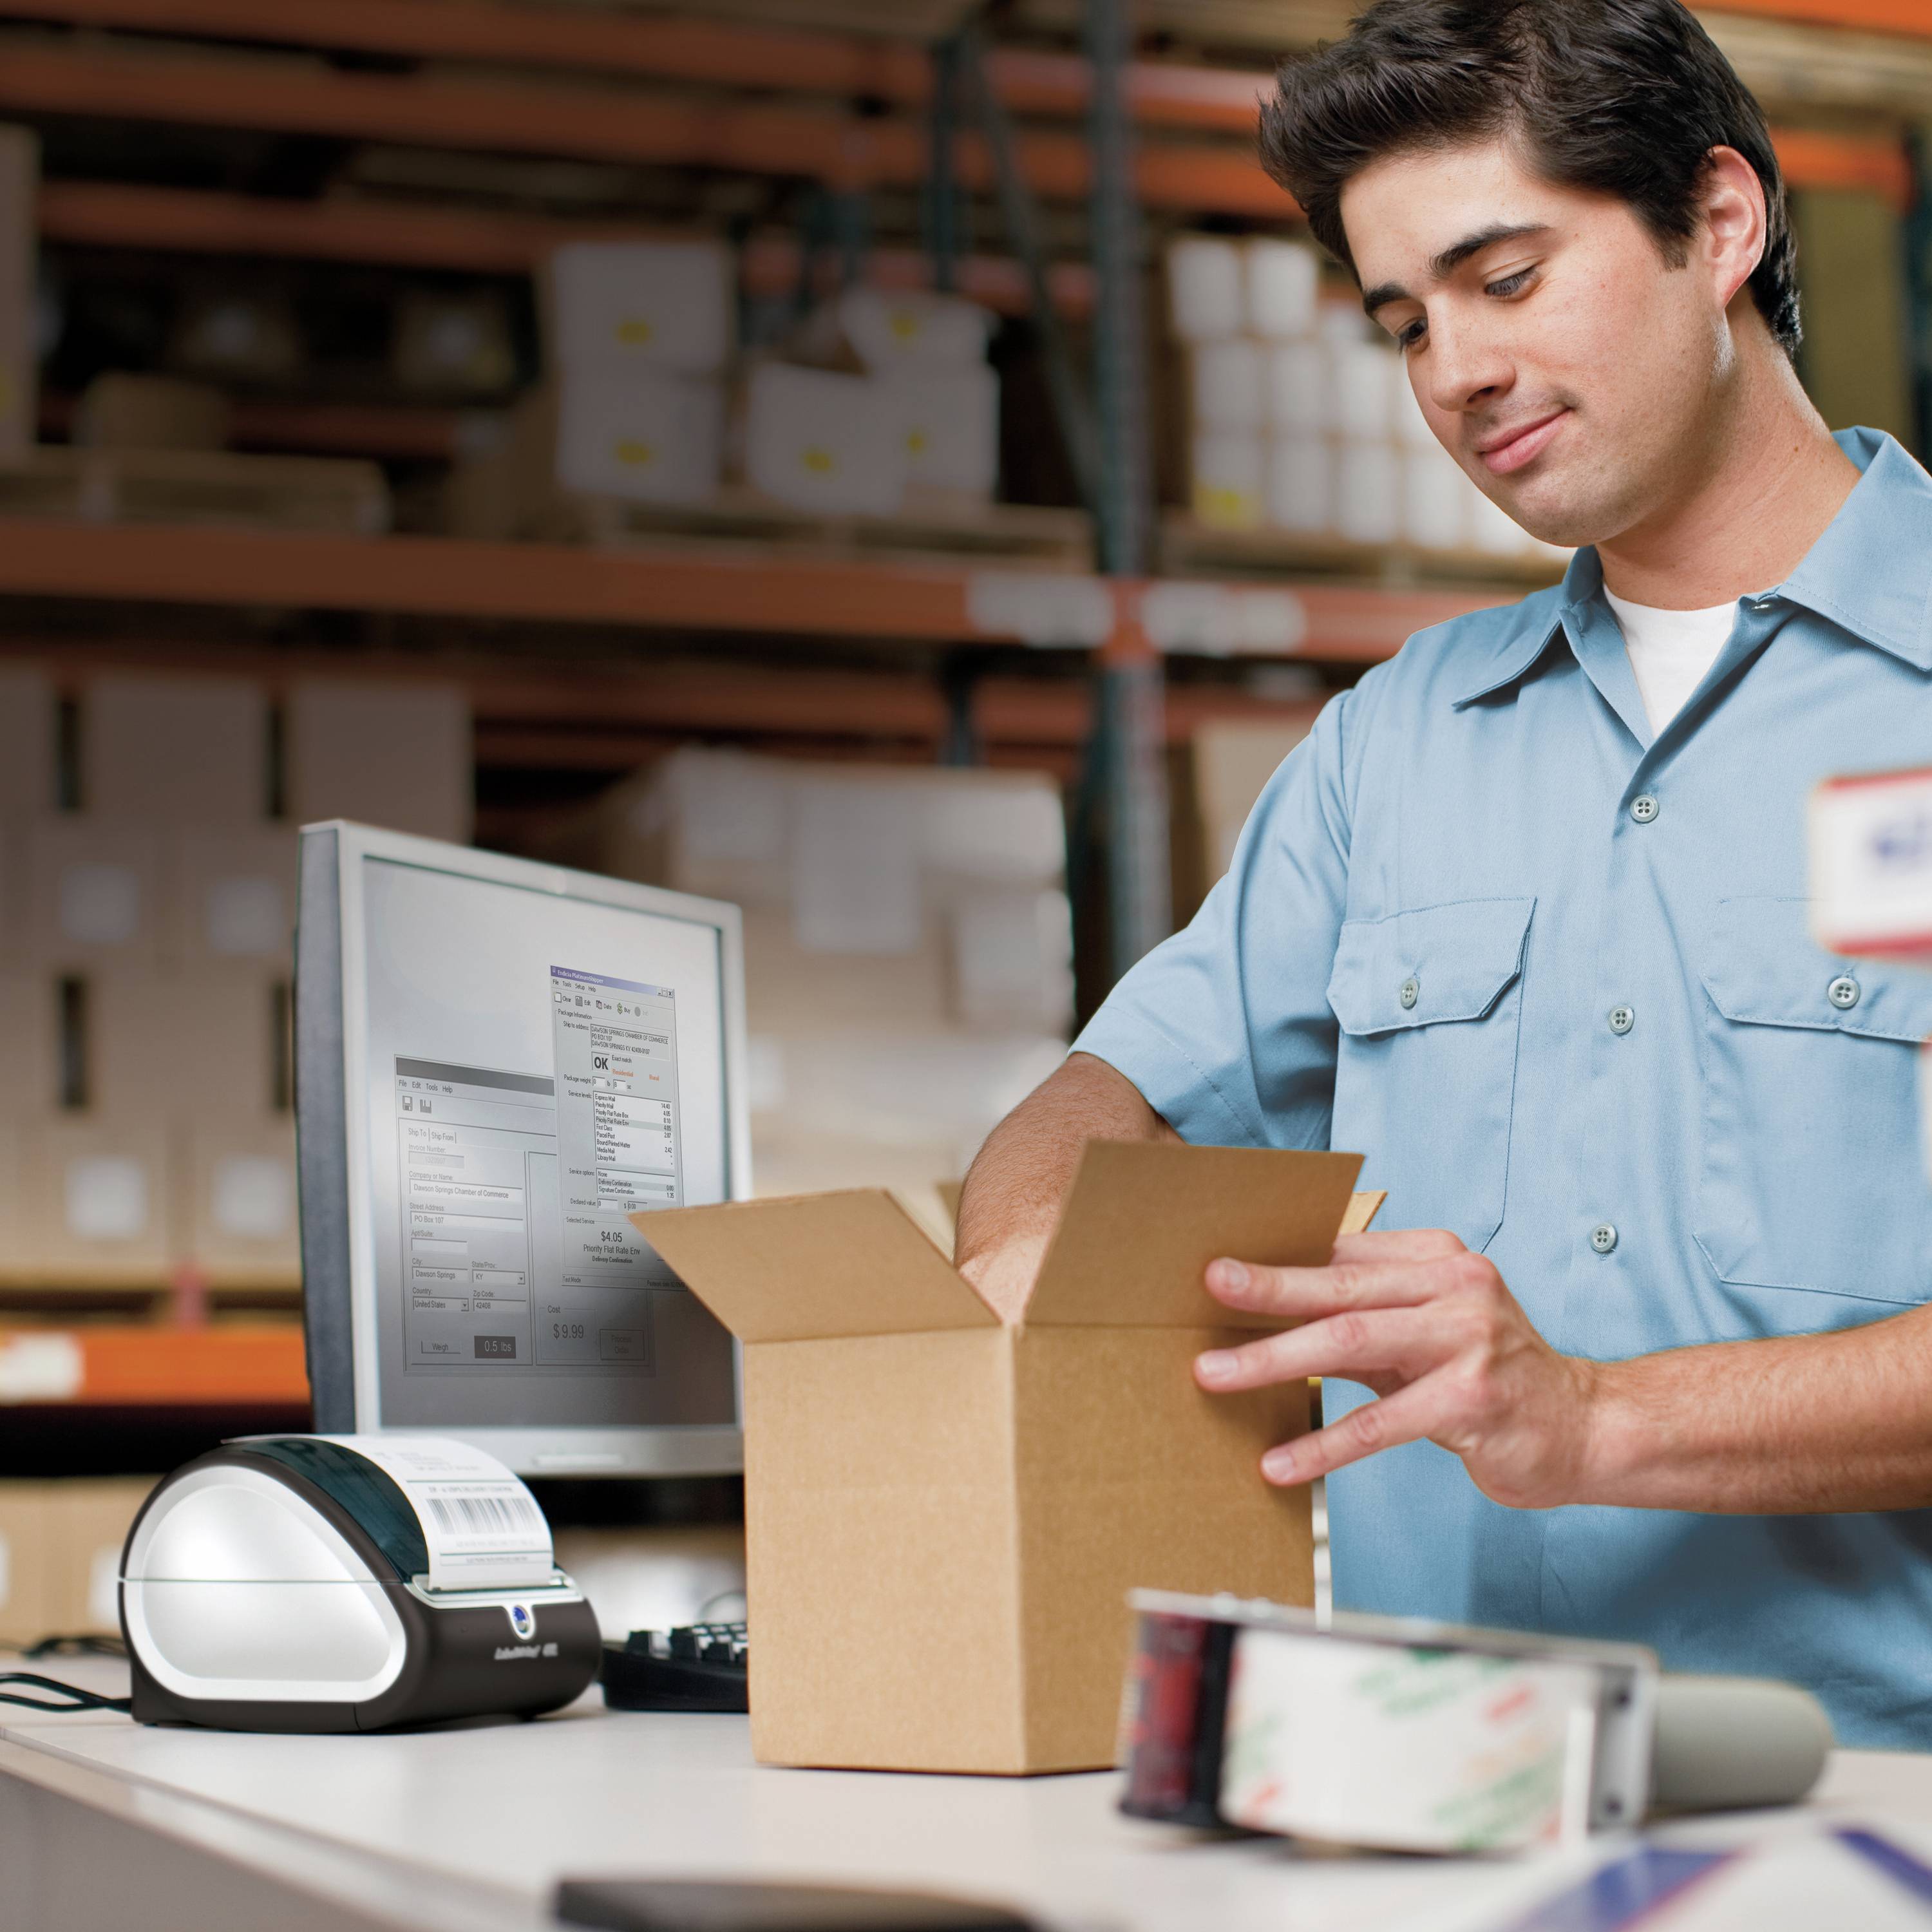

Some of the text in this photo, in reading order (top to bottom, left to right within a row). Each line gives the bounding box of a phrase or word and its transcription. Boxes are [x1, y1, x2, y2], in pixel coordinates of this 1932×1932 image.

[558, 1009, 573, 1018] Package
[609, 1029, 625, 1037] SPRINGS
[625, 1032, 643, 1041] CHAMBER
[648, 1036, 668, 1045] COMMERCE
[592, 1040, 609, 1048] DAWSON
[609, 1043, 625, 1051] SPRINGS
[594, 1056, 609, 1070] OK
[564, 1074, 580, 1083] Package
[412, 1081, 421, 1089] Edit
[596, 1116, 607, 1124] Priority
[408, 1128, 418, 1137] Ship
[431, 1131, 442, 1141] Ship
[442, 1133, 453, 1141] From
[409, 1171, 431, 1180] Company
[435, 1185, 454, 1195] Springs
[455, 1188, 477, 1196] Chamber
[483, 1190, 509, 1199] Commerce
[410, 1202, 424, 1211] Street
[601, 1231, 622, 1243] $4.05
[583, 1244, 640, 1255] Priority Flat Rate Env
[412, 1257, 423, 1266] City:
[437, 1271, 456, 1280] Springs
[412, 1287, 433, 1296] Country:
[547, 1305, 561, 1314] Cost
[431, 1341, 512, 1352] Weigh 0.5 lbs
